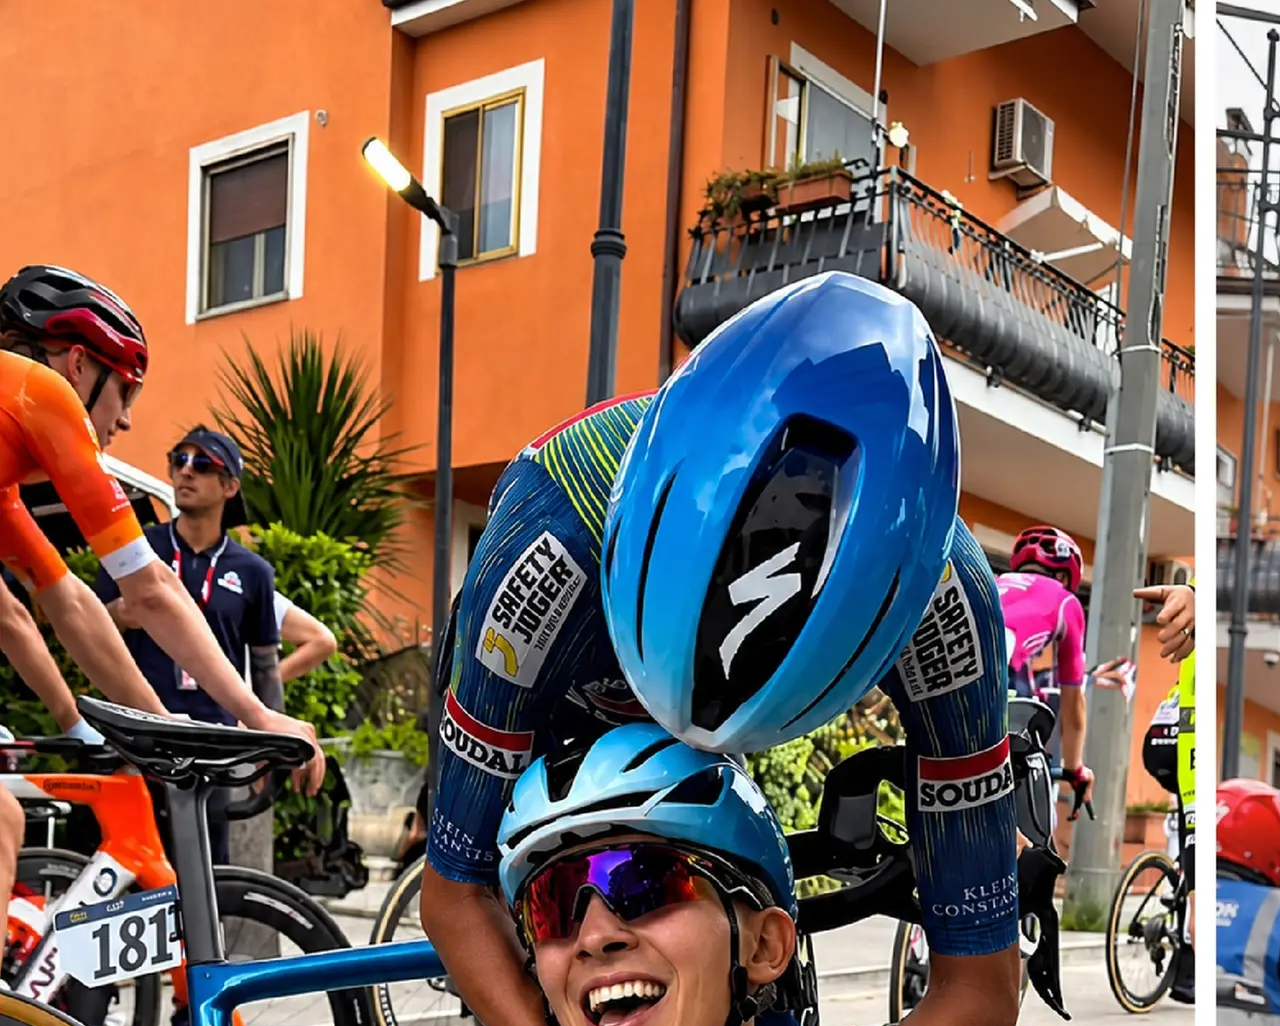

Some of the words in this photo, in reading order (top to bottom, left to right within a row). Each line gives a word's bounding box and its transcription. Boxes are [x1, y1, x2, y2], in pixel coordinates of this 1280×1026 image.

[492, 537, 558, 631] SAFETY
[933, 585, 980, 681] SAFETY
[919, 764, 1015, 808] SOUDA
[92, 907, 174, 980] 181
